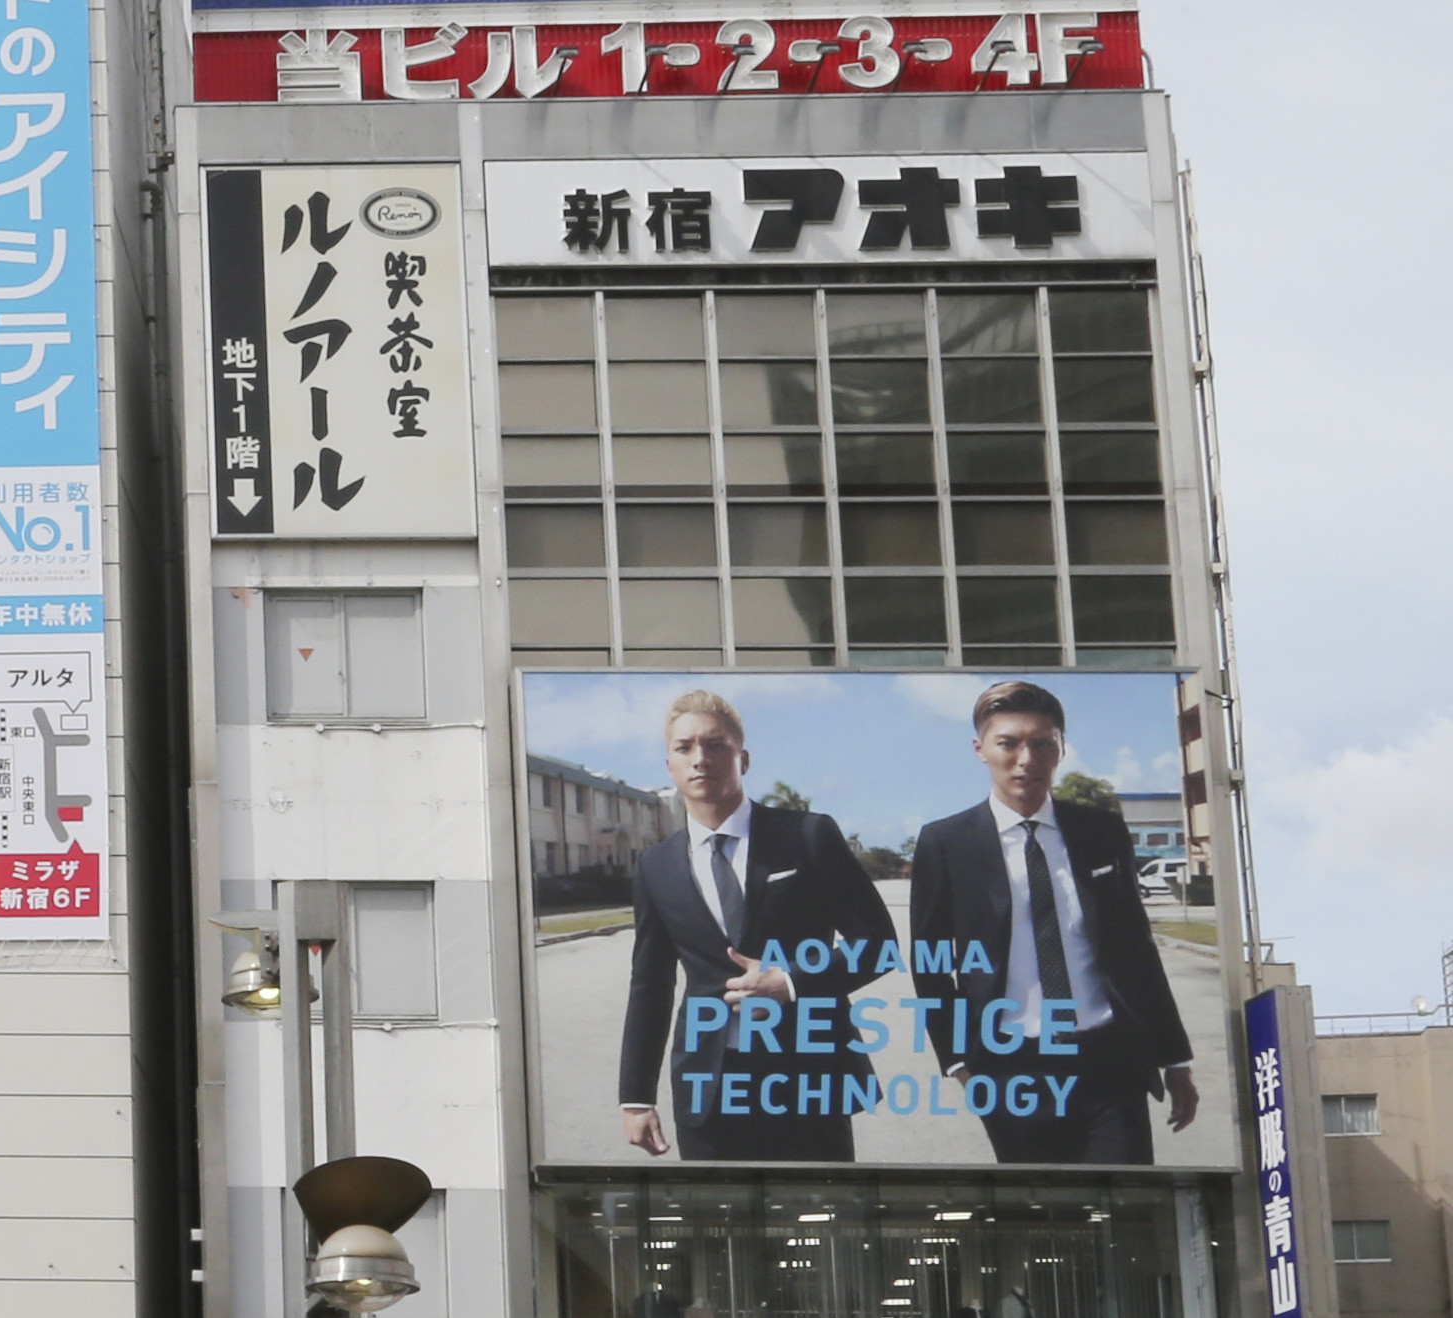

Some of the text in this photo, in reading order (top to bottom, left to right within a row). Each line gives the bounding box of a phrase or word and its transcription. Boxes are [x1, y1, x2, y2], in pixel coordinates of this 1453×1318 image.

[563, 166, 1081, 253] 新宿 アオキ
[280, 191, 366, 511] ルノアール
[380, 251, 433, 438] 喫茶室
[222, 337, 261, 470] 地下1階
[8, 668, 74, 687] アルタ
[11, 727, 35, 738] 東口
[22, 776, 35, 825] 中央東口
[12, 861, 79, 881] ミラザ
[0, 887, 91, 909] 新宿6F
[759, 938, 994, 975] AOYAMA
[684, 997, 1080, 1056] PRESTIGE
[682, 1073, 1078, 1117] TECHNOLOGY
[1254, 1048, 1297, 1315] 洋服の青山
